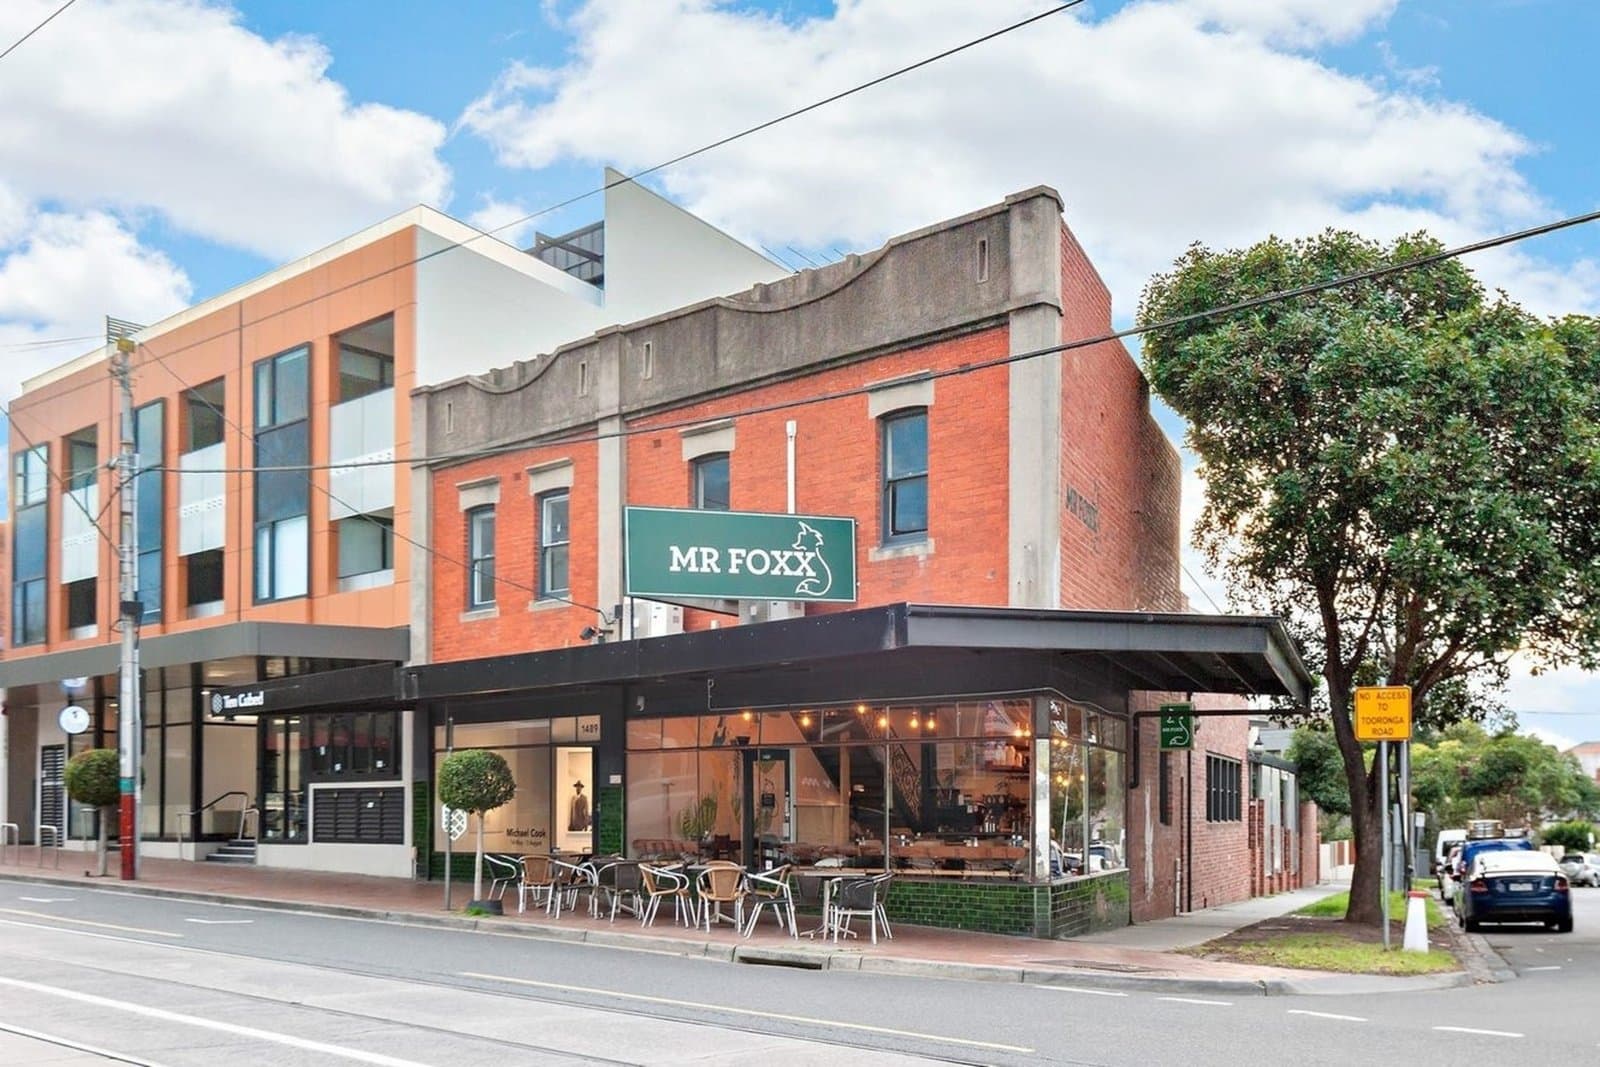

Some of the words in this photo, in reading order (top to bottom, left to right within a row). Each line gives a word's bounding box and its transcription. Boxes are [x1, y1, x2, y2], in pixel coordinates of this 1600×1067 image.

[669, 545, 721, 573] MR
[728, 547, 817, 577] FOXX
[1359, 692, 1371, 700] NO
[1376, 691, 1407, 700] ACCESS
[1377, 702, 1389, 711] TO
[1361, 716, 1405, 725] TOORONGA
[581, 723, 598, 734] 1489
[1371, 727, 1394, 736] ROAD
[506, 827, 529, 838] Michael
[530, 828, 546, 838] Cook
